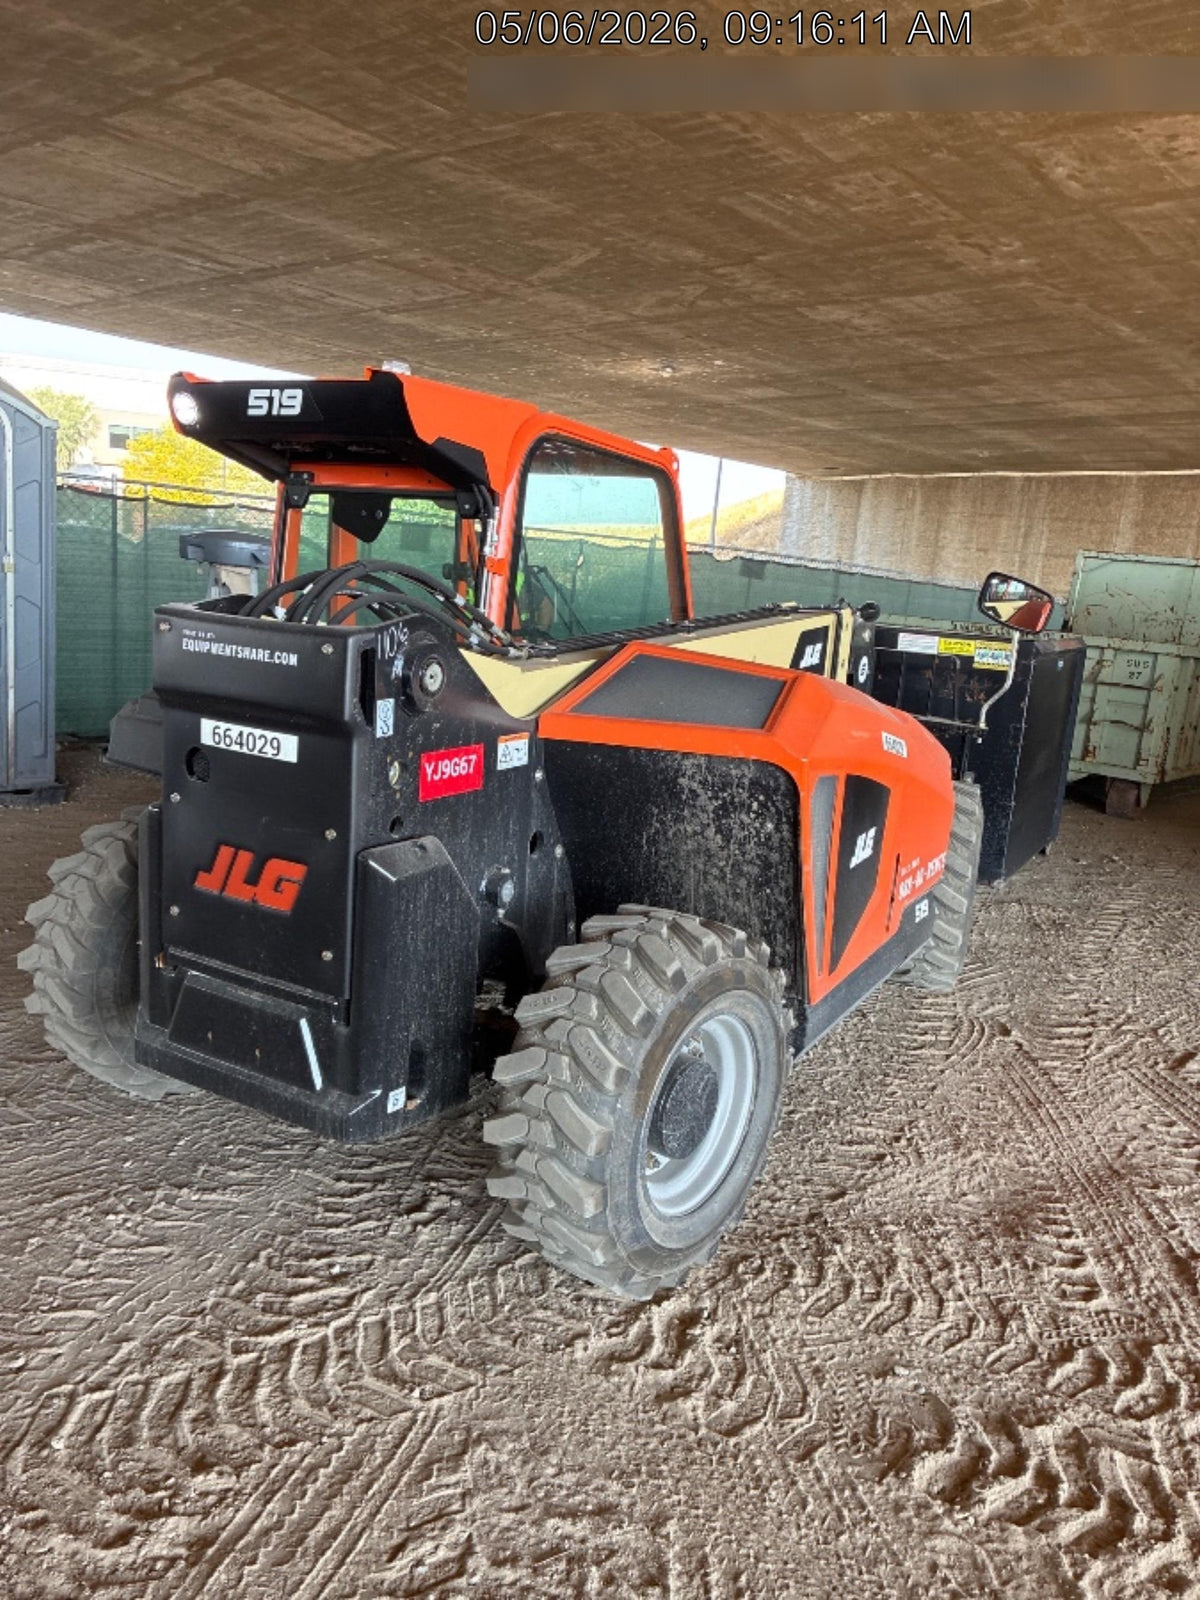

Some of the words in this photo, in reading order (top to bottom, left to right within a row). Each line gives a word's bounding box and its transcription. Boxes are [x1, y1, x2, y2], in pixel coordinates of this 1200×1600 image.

[247, 388, 303, 416] 519
[182, 638, 298, 667] EQUIPMENTSHARE.COM
[212, 725, 281, 757] 664029
[424, 754, 478, 782] YJ9G67
[849, 826, 877, 869] JLG
[193, 844, 309, 914] JLG
